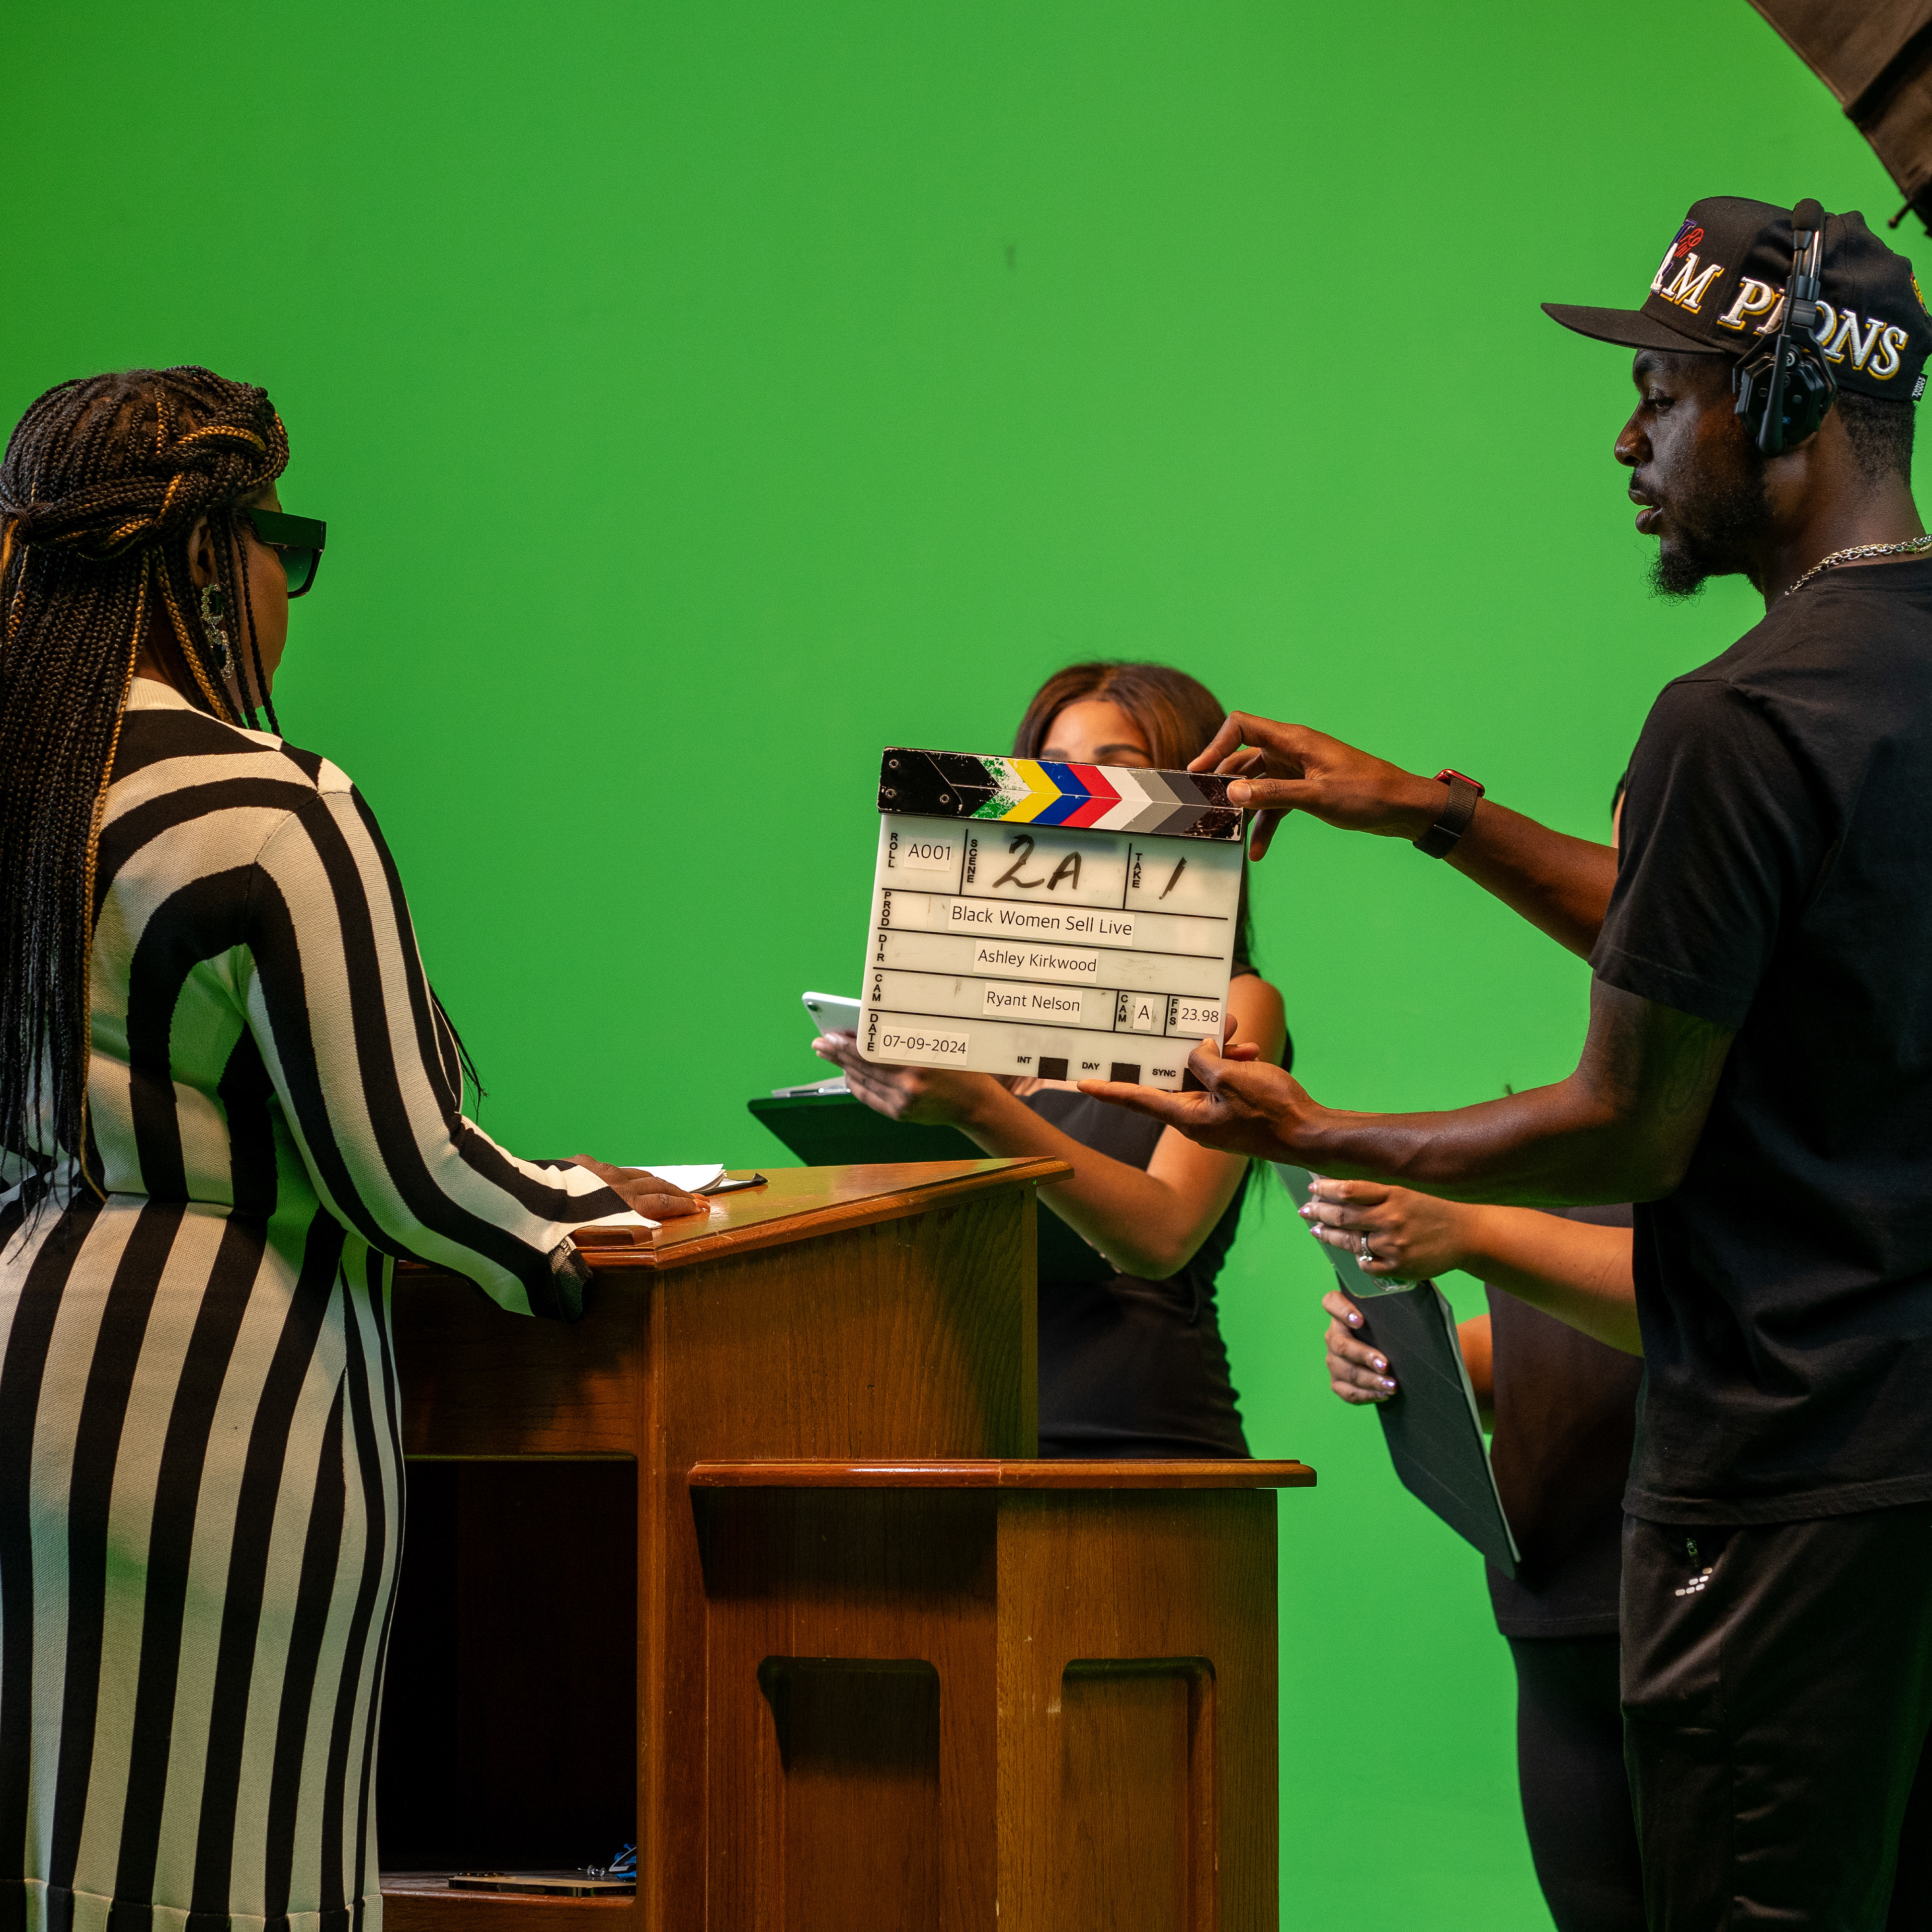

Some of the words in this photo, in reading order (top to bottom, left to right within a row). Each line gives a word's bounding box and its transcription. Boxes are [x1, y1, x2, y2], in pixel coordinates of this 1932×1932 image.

[888, 832, 899, 868] ROLL
[908, 843, 951, 861] A001
[967, 839, 978, 883] SCENE
[1132, 852, 1143, 889] TAKE
[880, 891, 892, 926] PROD
[951, 906, 994, 923] Black
[1000, 910, 1060, 929] Women
[1065, 916, 1094, 932] Sell
[1099, 919, 1132, 936] Live
[876, 934, 888, 962] DIR
[978, 949, 1025, 968] Ashley
[1029, 953, 1097, 972] Kirkwood
[871, 974, 883, 1002] CAM
[986, 991, 1027, 1007] Ryant
[1031, 995, 1081, 1012] Nelson
[1118, 994, 1129, 1023] CAM
[1138, 1005, 1150, 1020] A
[1169, 998, 1179, 1025] FPS
[1181, 1008, 1219, 1023] 23.98
[867, 1013, 879, 1052] DATE
[883, 1034, 967, 1055] 07-09-2024
[1017, 1056, 1032, 1064] INT
[1081, 1062, 1100, 1070] DAY
[1152, 1068, 1177, 1077] SYNC
